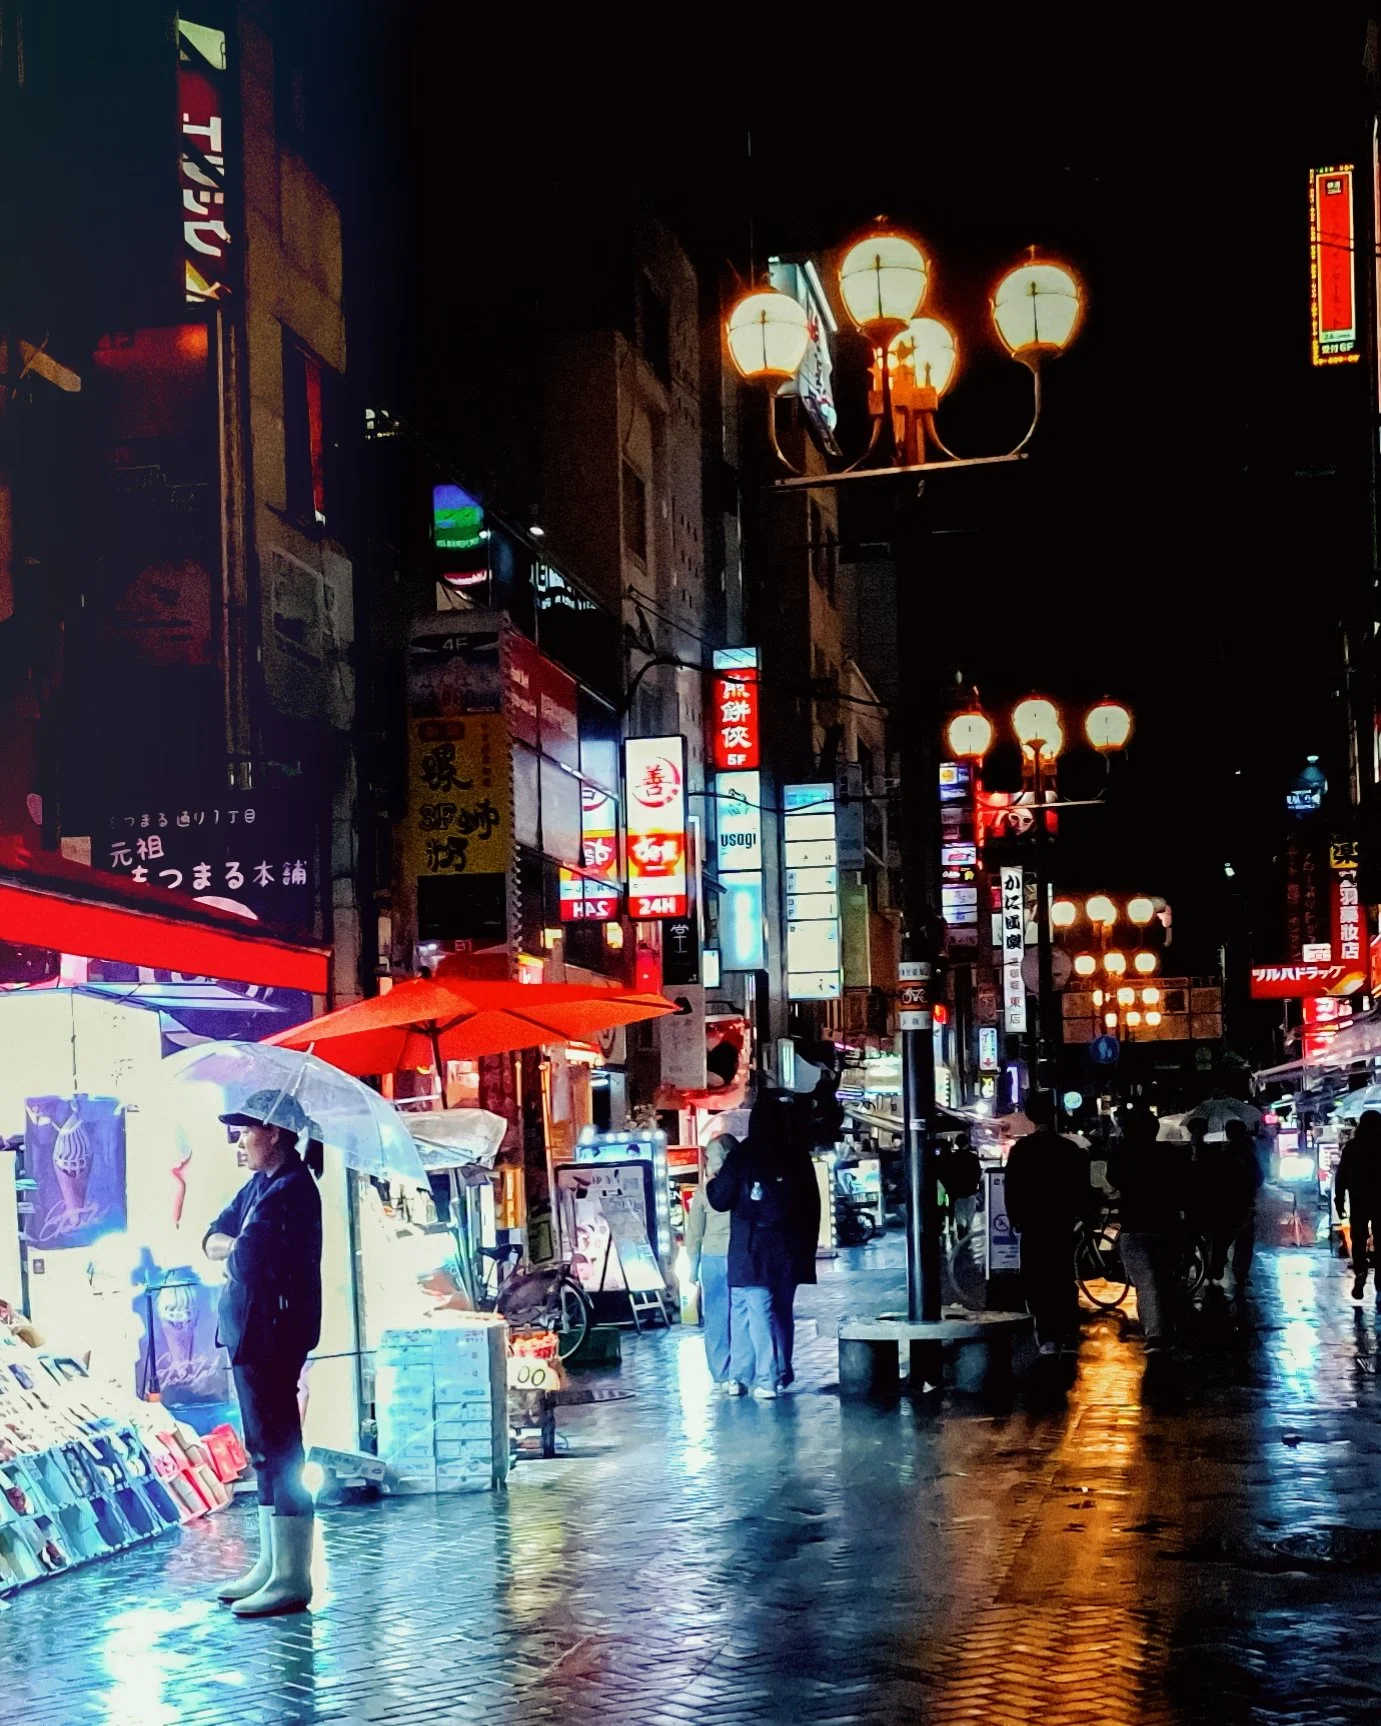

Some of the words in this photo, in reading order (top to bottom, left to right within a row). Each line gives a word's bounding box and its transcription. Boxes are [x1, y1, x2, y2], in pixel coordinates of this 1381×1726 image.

[442, 637, 469, 650] 4F
[727, 754, 747, 766] 5F
[643, 764, 674, 798] 善
[720, 827, 757, 850] usagi
[109, 835, 165, 868] 元祖
[638, 898, 676, 916] 24H
